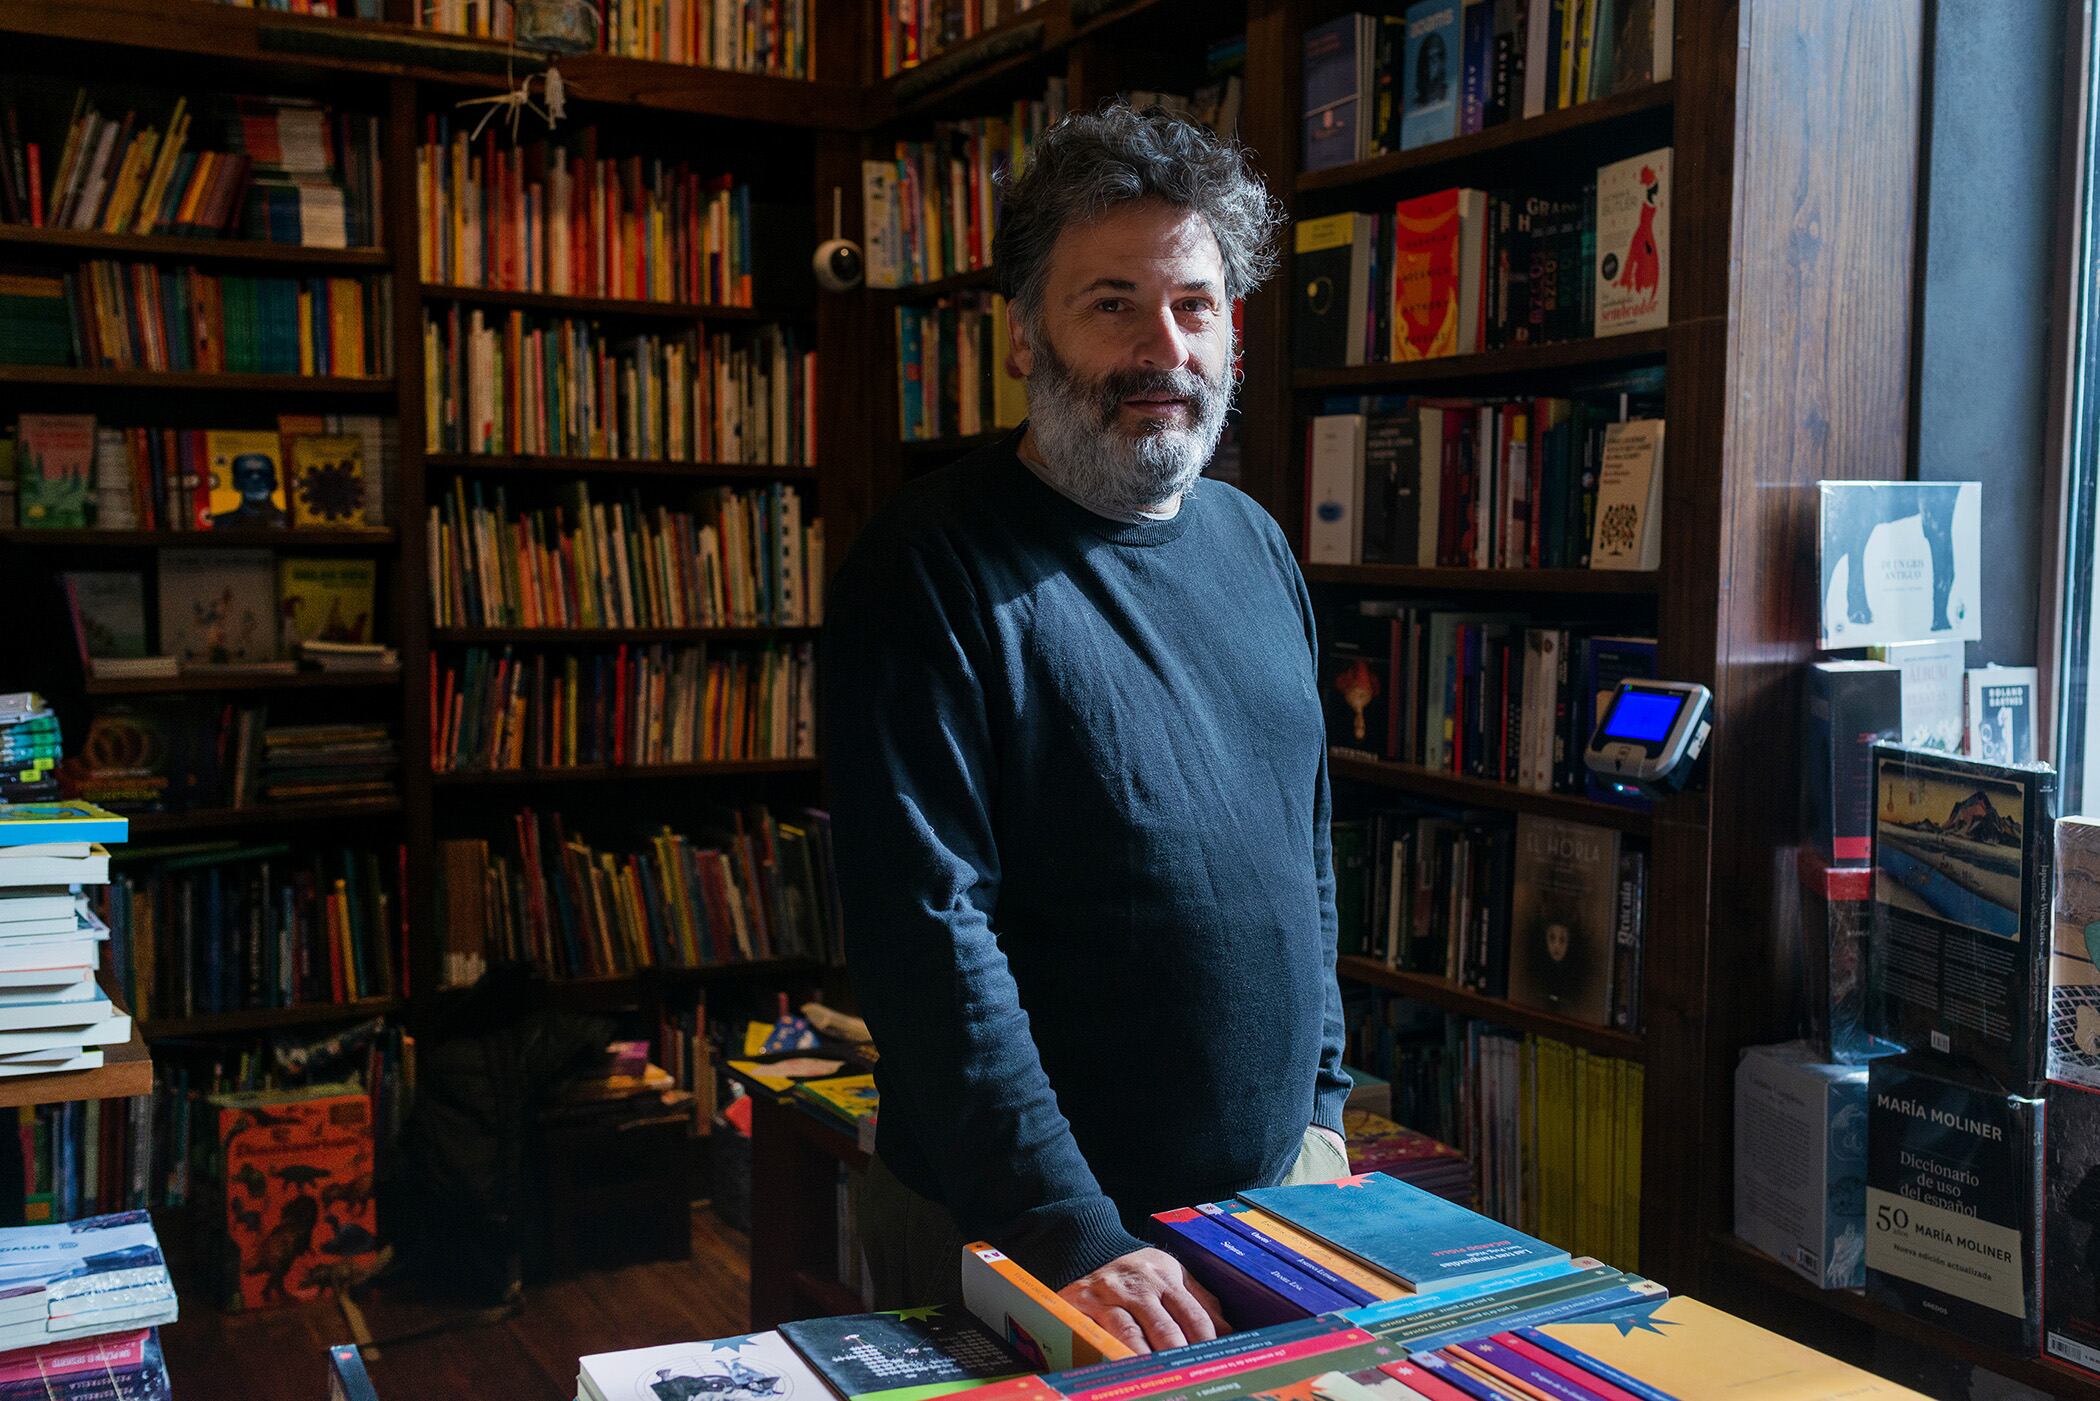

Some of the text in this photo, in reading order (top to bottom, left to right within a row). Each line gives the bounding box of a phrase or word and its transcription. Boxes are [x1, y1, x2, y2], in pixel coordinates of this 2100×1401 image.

[1877, 1094, 2003, 1142] MARÍA MOLINER
[1900, 1151, 1980, 1187] Diccionario
[1916, 1173, 1961, 1198] de uso
[1876, 1204, 1908, 1232] 50
[1900, 1184, 1978, 1220] del español
[1914, 1221, 2012, 1264] MARÍA MOLINER
[1918, 1251, 1946, 1266] edición
[1946, 1258, 1993, 1282] actualizada
